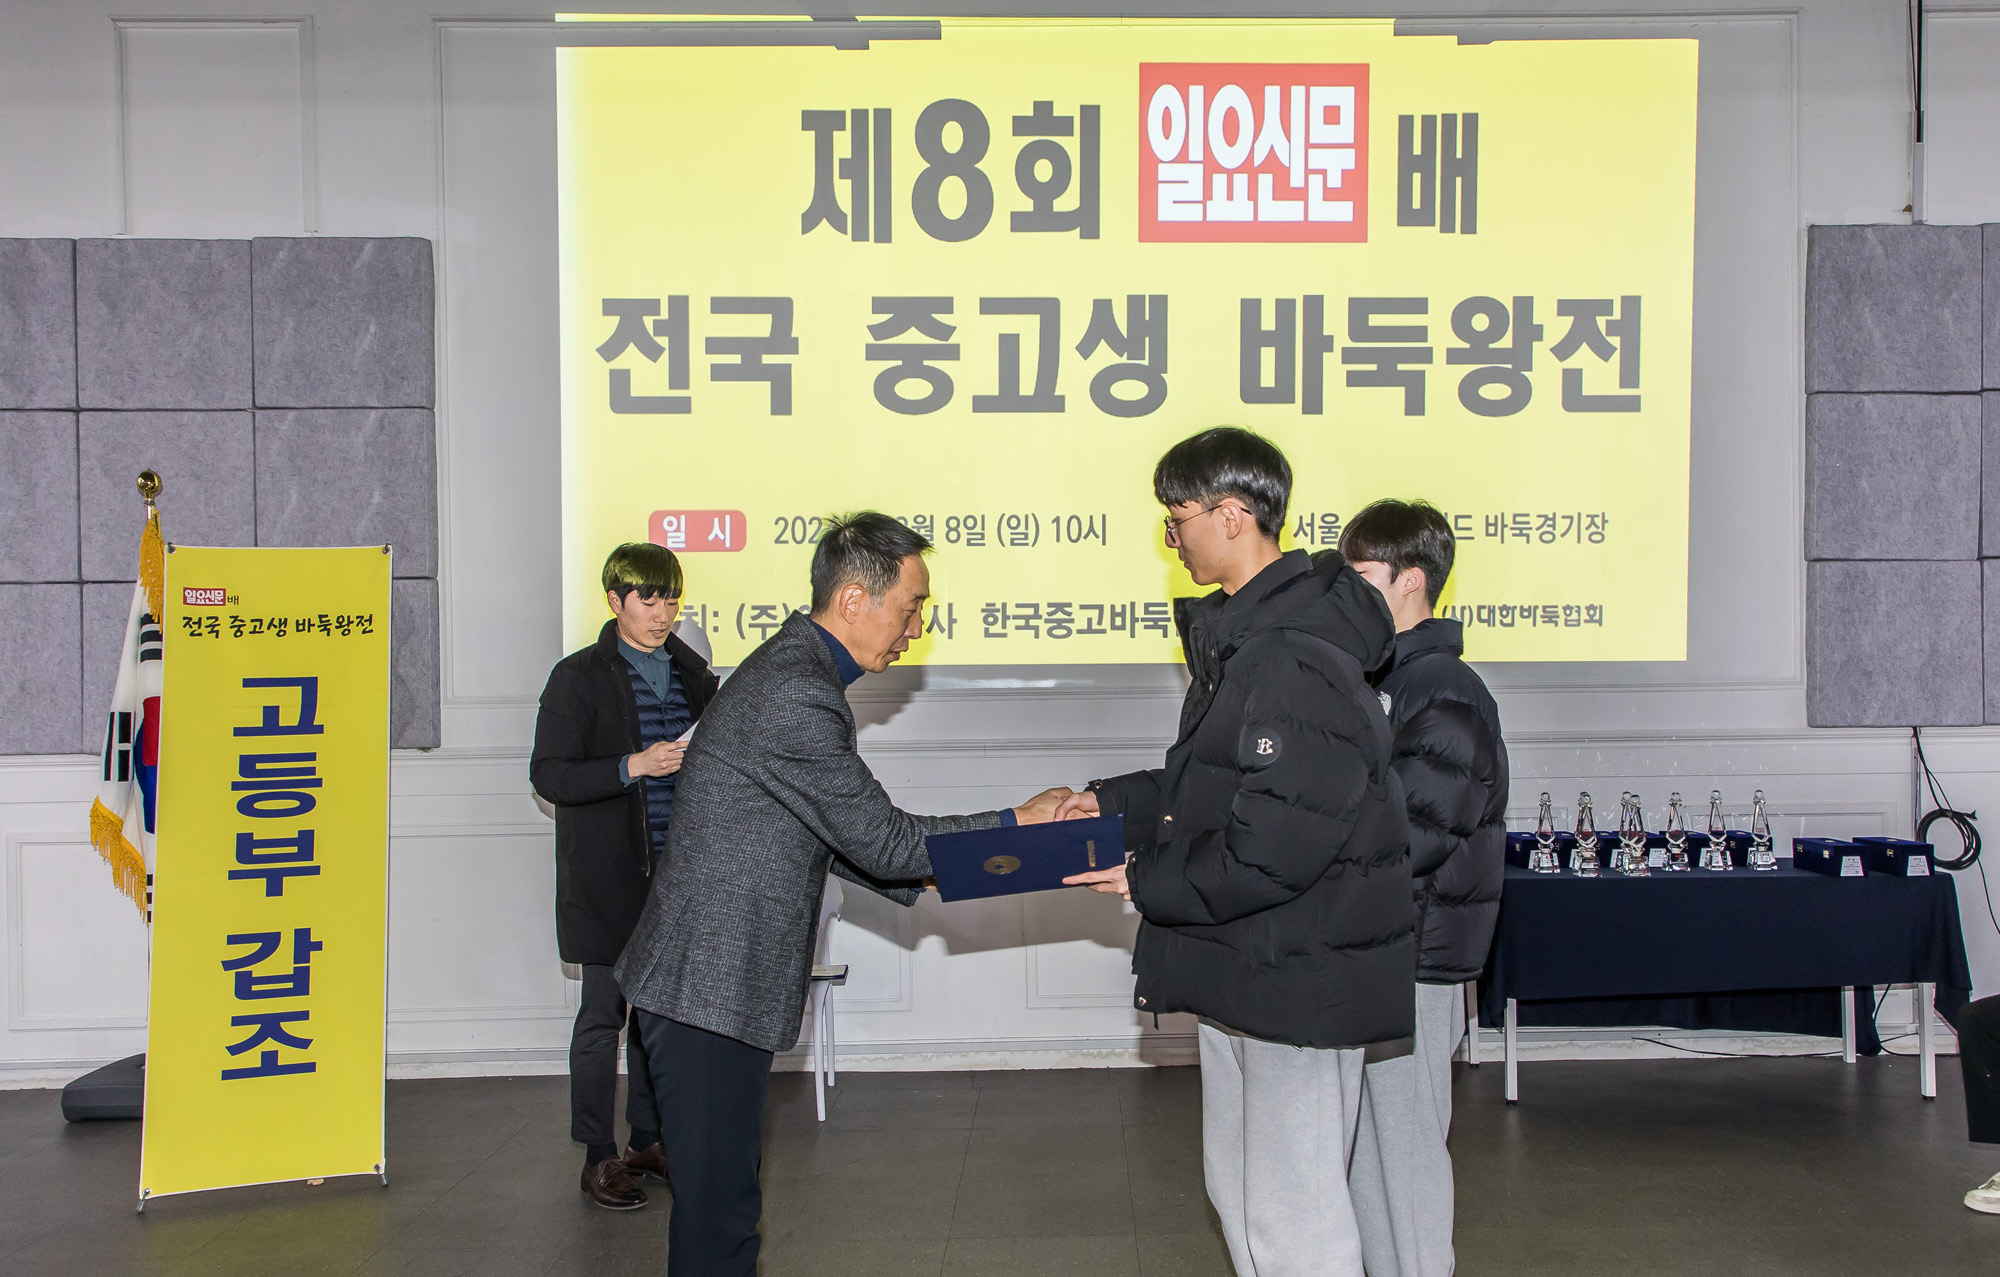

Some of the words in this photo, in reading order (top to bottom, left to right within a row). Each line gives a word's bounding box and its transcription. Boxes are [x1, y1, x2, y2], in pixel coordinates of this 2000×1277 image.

[801, 98, 1101, 243] 제8회
[1147, 84, 1356, 222] 일요신문
[1397, 113, 1479, 234] 배
[595, 295, 799, 416] 전국
[865, 294, 1169, 418] 중고생
[1239, 294, 1642, 418] 바둑왕전
[774, 515, 822, 545] 202
[945, 514, 986, 546] 8일
[995, 512, 1040, 548] (일)
[1050, 513, 1108, 547] 10시
[1293, 512, 1341, 545] 서울
[1485, 511, 1609, 545] 바둑경기장
[184, 589, 224, 605] 일요신문
[226, 594, 240, 605] 배
[181, 615, 221, 639] 전국
[228, 614, 289, 639] 중고생
[295, 613, 375, 637] 바둑왕전
[980, 601, 1181, 639] 한국중고바둑
[227, 675, 325, 898] 고등부
[220, 927, 324, 1081] 갑조
